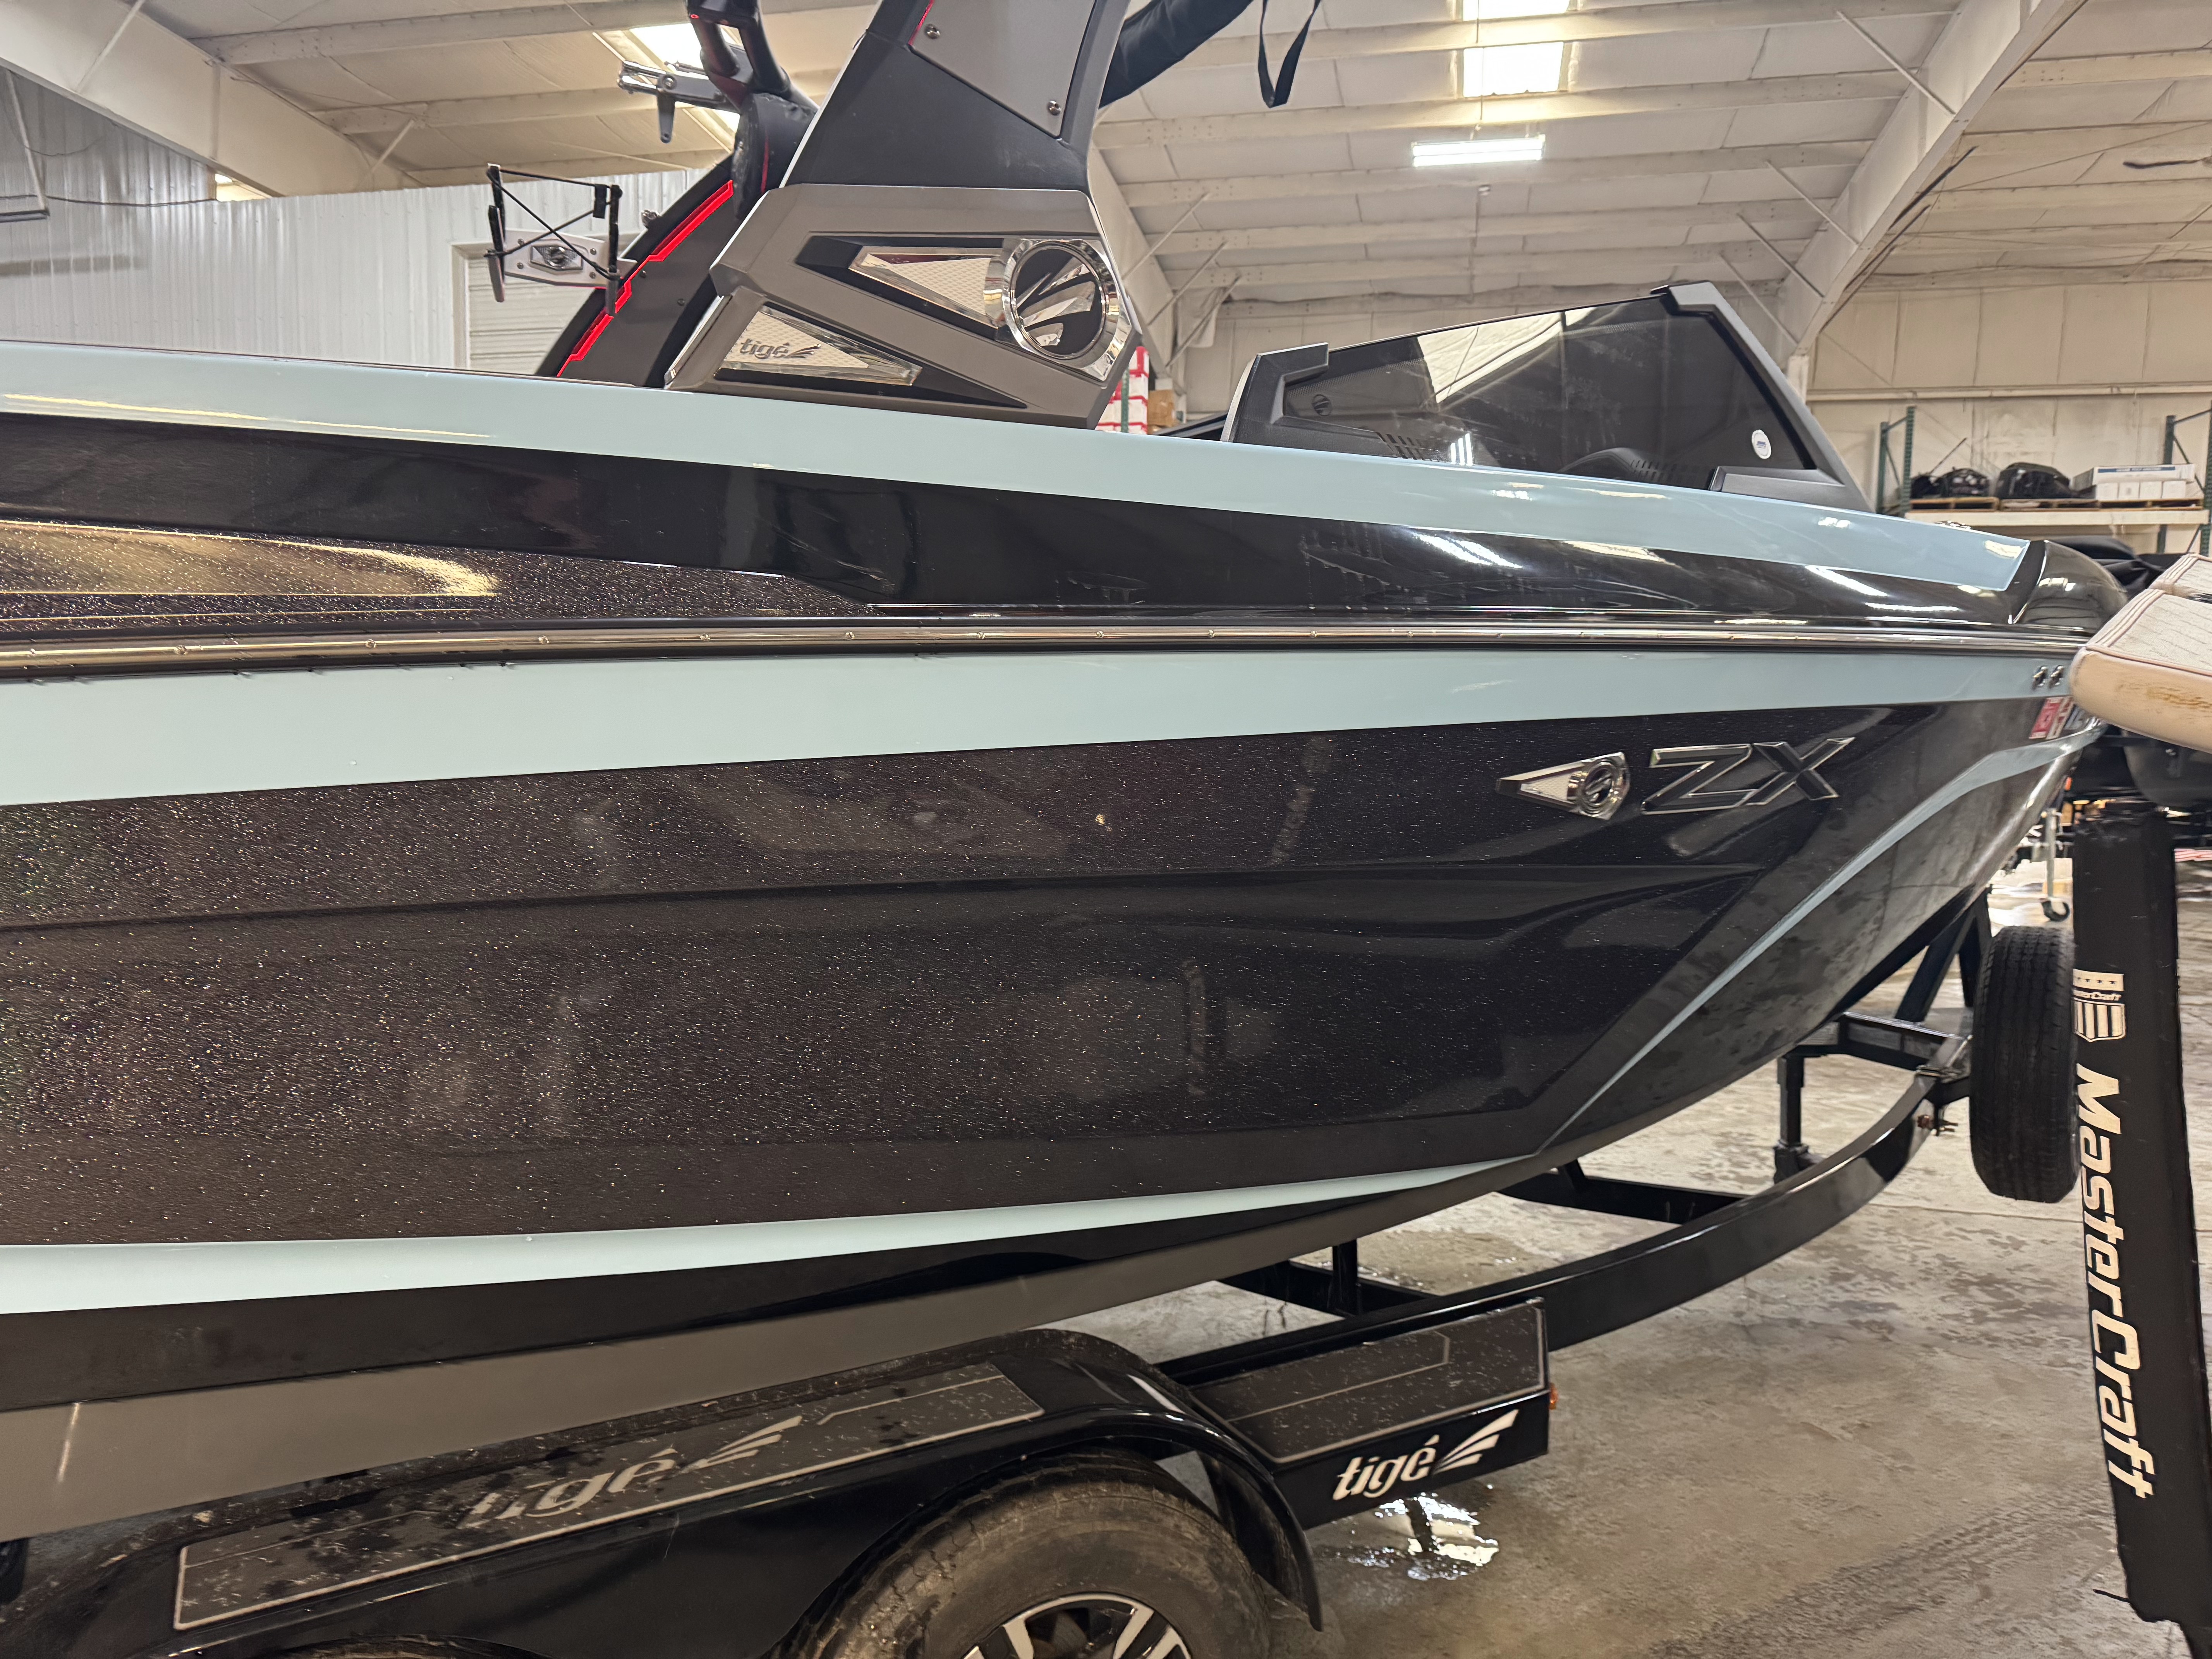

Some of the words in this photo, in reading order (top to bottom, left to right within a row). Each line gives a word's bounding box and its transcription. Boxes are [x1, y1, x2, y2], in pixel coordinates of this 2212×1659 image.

[740, 338, 790, 359] tigé
[1640, 737, 1856, 815] ZX
[2076, 1062, 2155, 1500] MasterCraft
[1332, 1434, 1439, 1501] tigé
